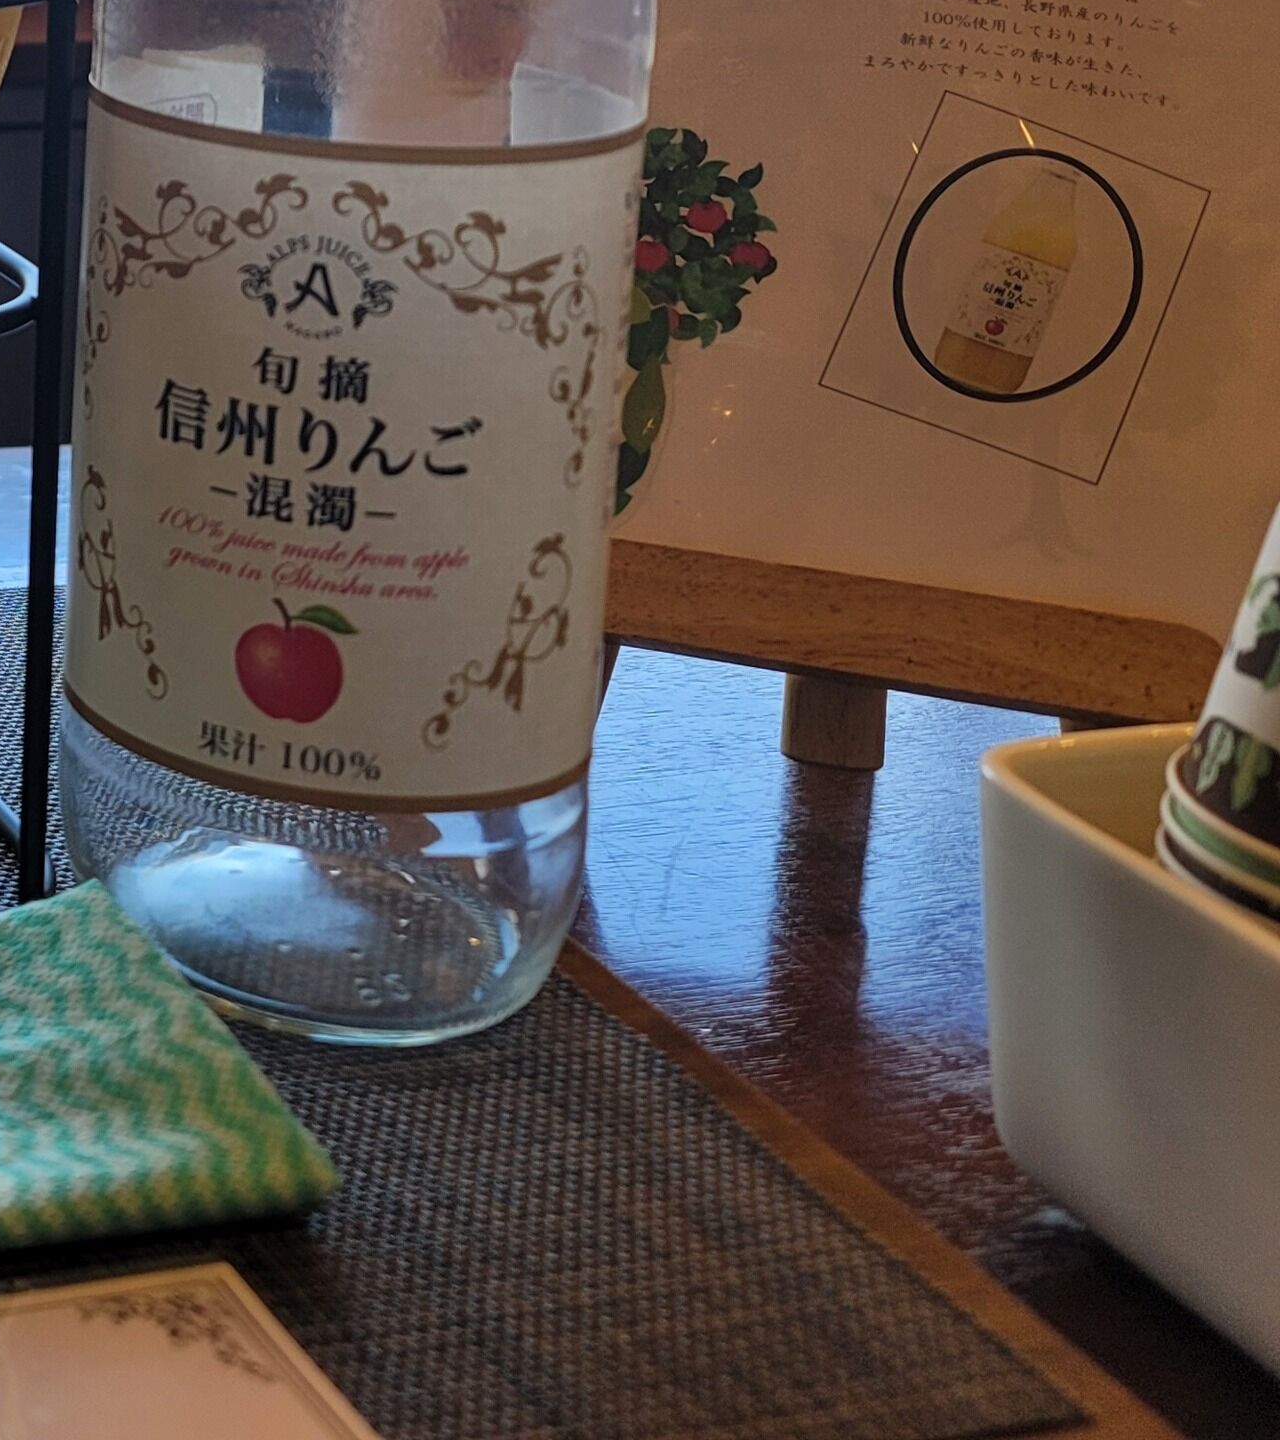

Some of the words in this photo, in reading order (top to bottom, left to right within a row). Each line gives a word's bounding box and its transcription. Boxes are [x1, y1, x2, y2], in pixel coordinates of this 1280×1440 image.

[153, 377, 485, 477] 信州りんご
[157, 504, 225, 538] 100%
[213, 529, 277, 554] juice
[281, 539, 347, 563] made
[340, 541, 408, 572] from
[412, 544, 470, 580] apple
[162, 544, 233, 576] grown
[236, 561, 263, 581] in
[270, 559, 375, 598] Shinshu
[197, 719, 267, 766] 果汁
[281, 740, 382, 783] 100%
